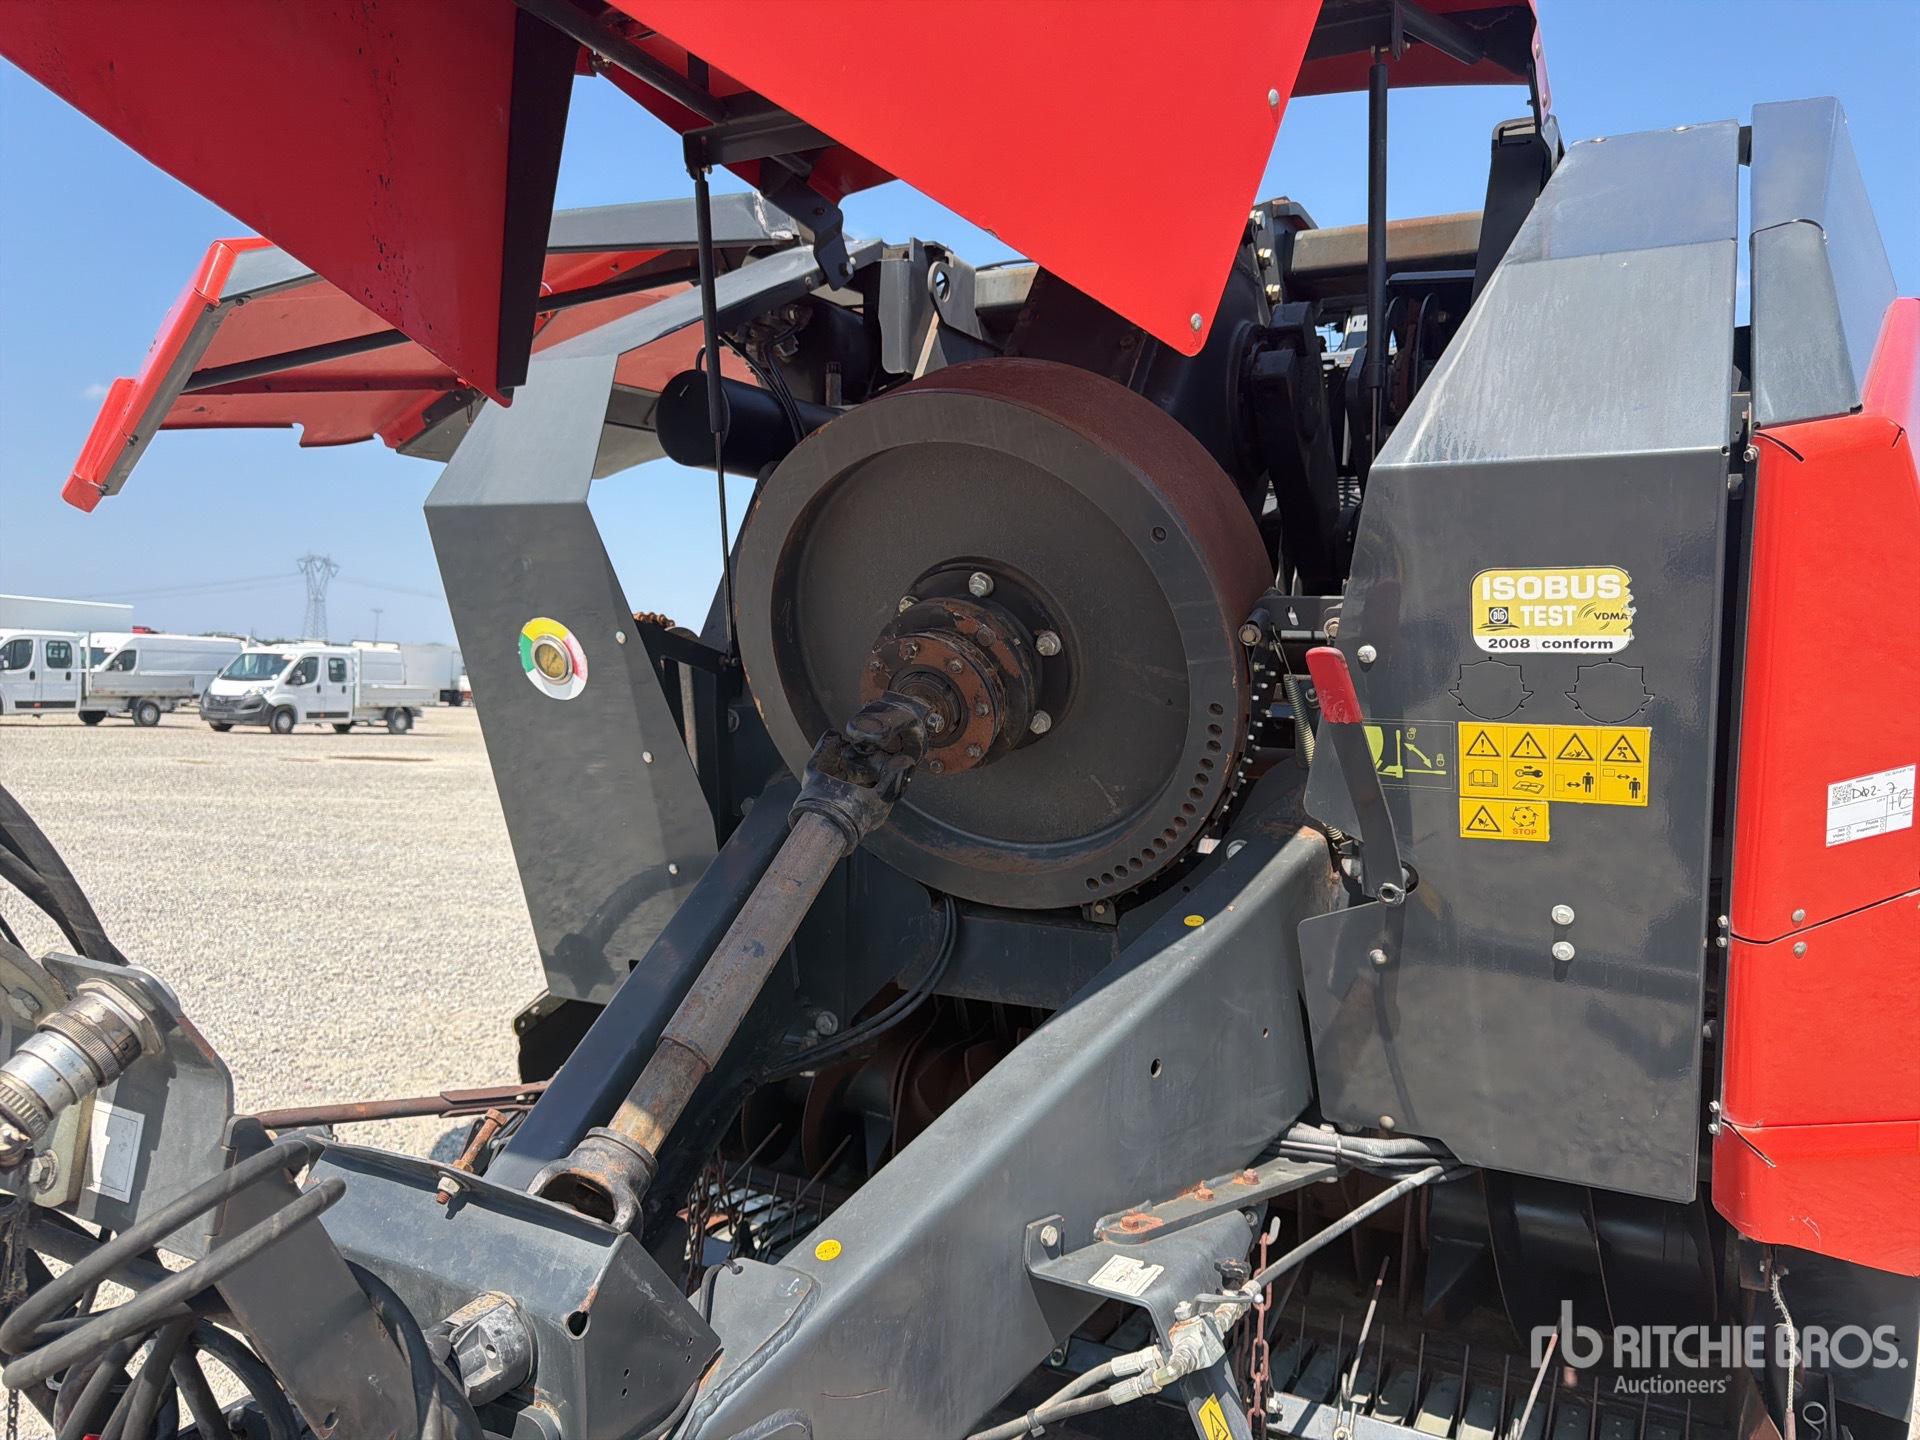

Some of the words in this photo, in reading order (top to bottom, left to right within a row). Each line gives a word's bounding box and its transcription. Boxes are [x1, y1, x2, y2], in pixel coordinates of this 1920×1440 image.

[1482, 574, 1621, 601] ISOBUS
[1519, 605, 1577, 627] TEST
[1593, 611, 1628, 621] VDMA
[1488, 638, 1531, 649] 2008
[1541, 638, 1614, 649] conform
[1512, 828, 1537, 836] STOP
